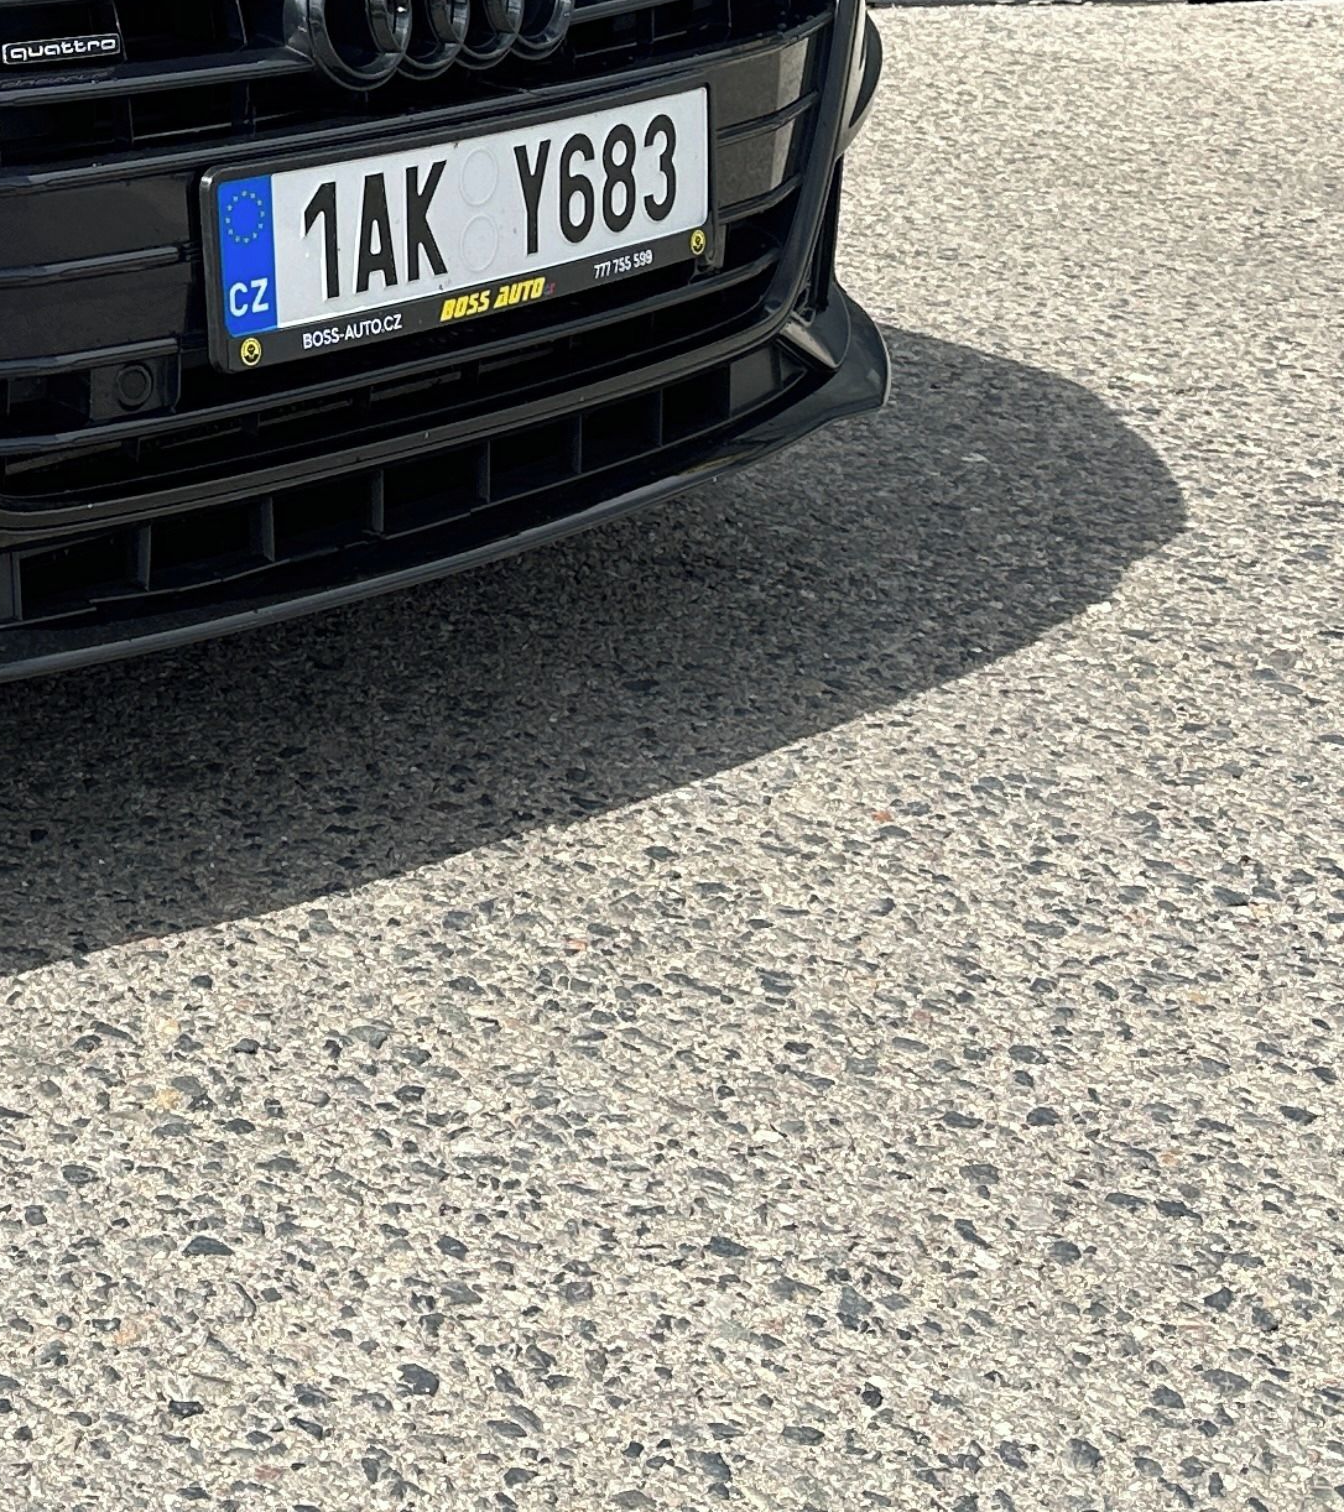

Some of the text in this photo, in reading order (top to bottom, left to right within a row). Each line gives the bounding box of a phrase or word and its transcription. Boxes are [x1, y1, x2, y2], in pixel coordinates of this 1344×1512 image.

[9, 38, 116, 62] quattro
[303, 114, 677, 300] 1AK Y683
[593, 249, 653, 279] 777 755 599
[229, 278, 269, 317] CZ
[440, 289, 491, 322] BOSS
[493, 276, 547, 309] AUTO
[302, 313, 403, 349] BOSS-AUTO.CZ
